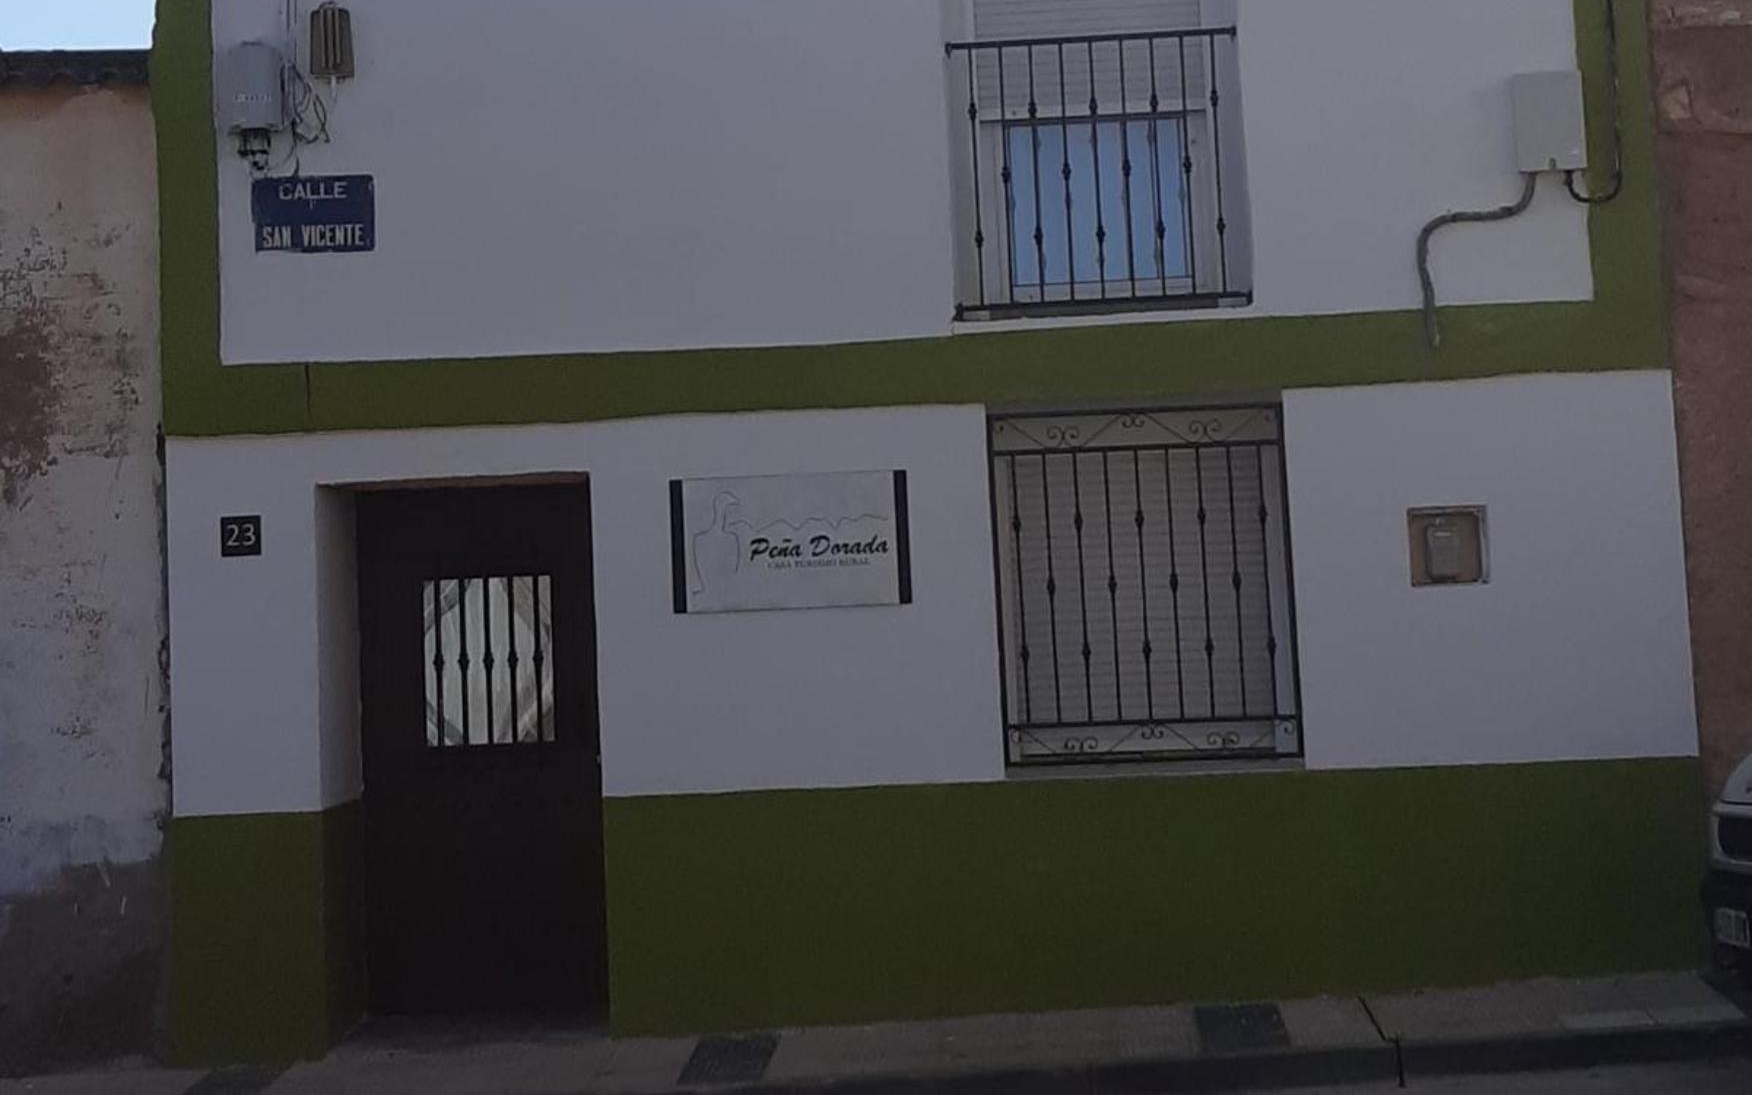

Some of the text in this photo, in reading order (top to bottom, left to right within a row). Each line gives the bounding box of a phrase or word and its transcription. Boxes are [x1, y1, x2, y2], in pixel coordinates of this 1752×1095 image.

[279, 181, 348, 200] CALLE
[262, 224, 364, 248] SAN VICENTE
[226, 523, 256, 546] 23
[750, 534, 889, 561] Peña Dorada
